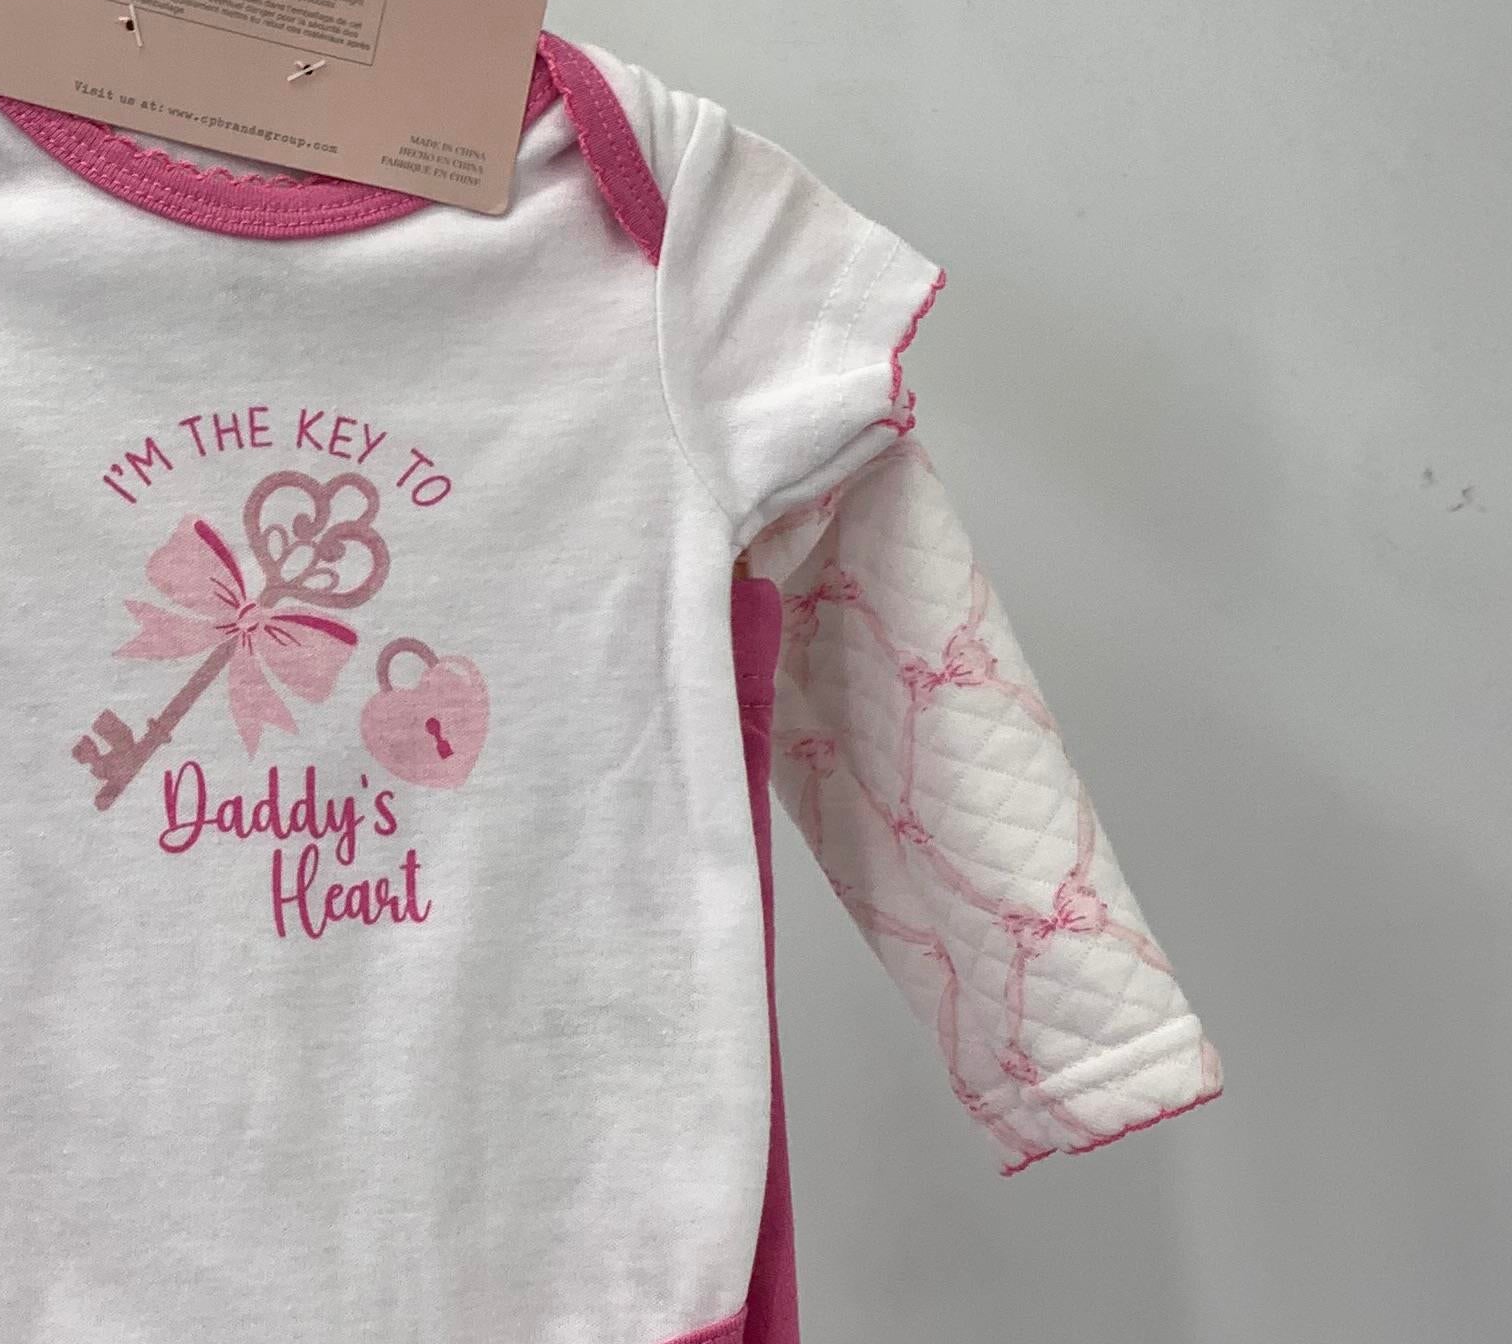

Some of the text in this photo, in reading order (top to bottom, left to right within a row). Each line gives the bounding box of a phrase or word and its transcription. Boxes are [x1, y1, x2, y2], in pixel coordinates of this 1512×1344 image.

[75, 80, 338, 153] Visit us at: www.cpbrandsgroup.com
[411, 136, 486, 161] MADE IN CHINA
[103, 406, 452, 506] I'M THE KEY TO
[158, 760, 398, 866] Daddy's
[271, 844, 431, 940] Heart
